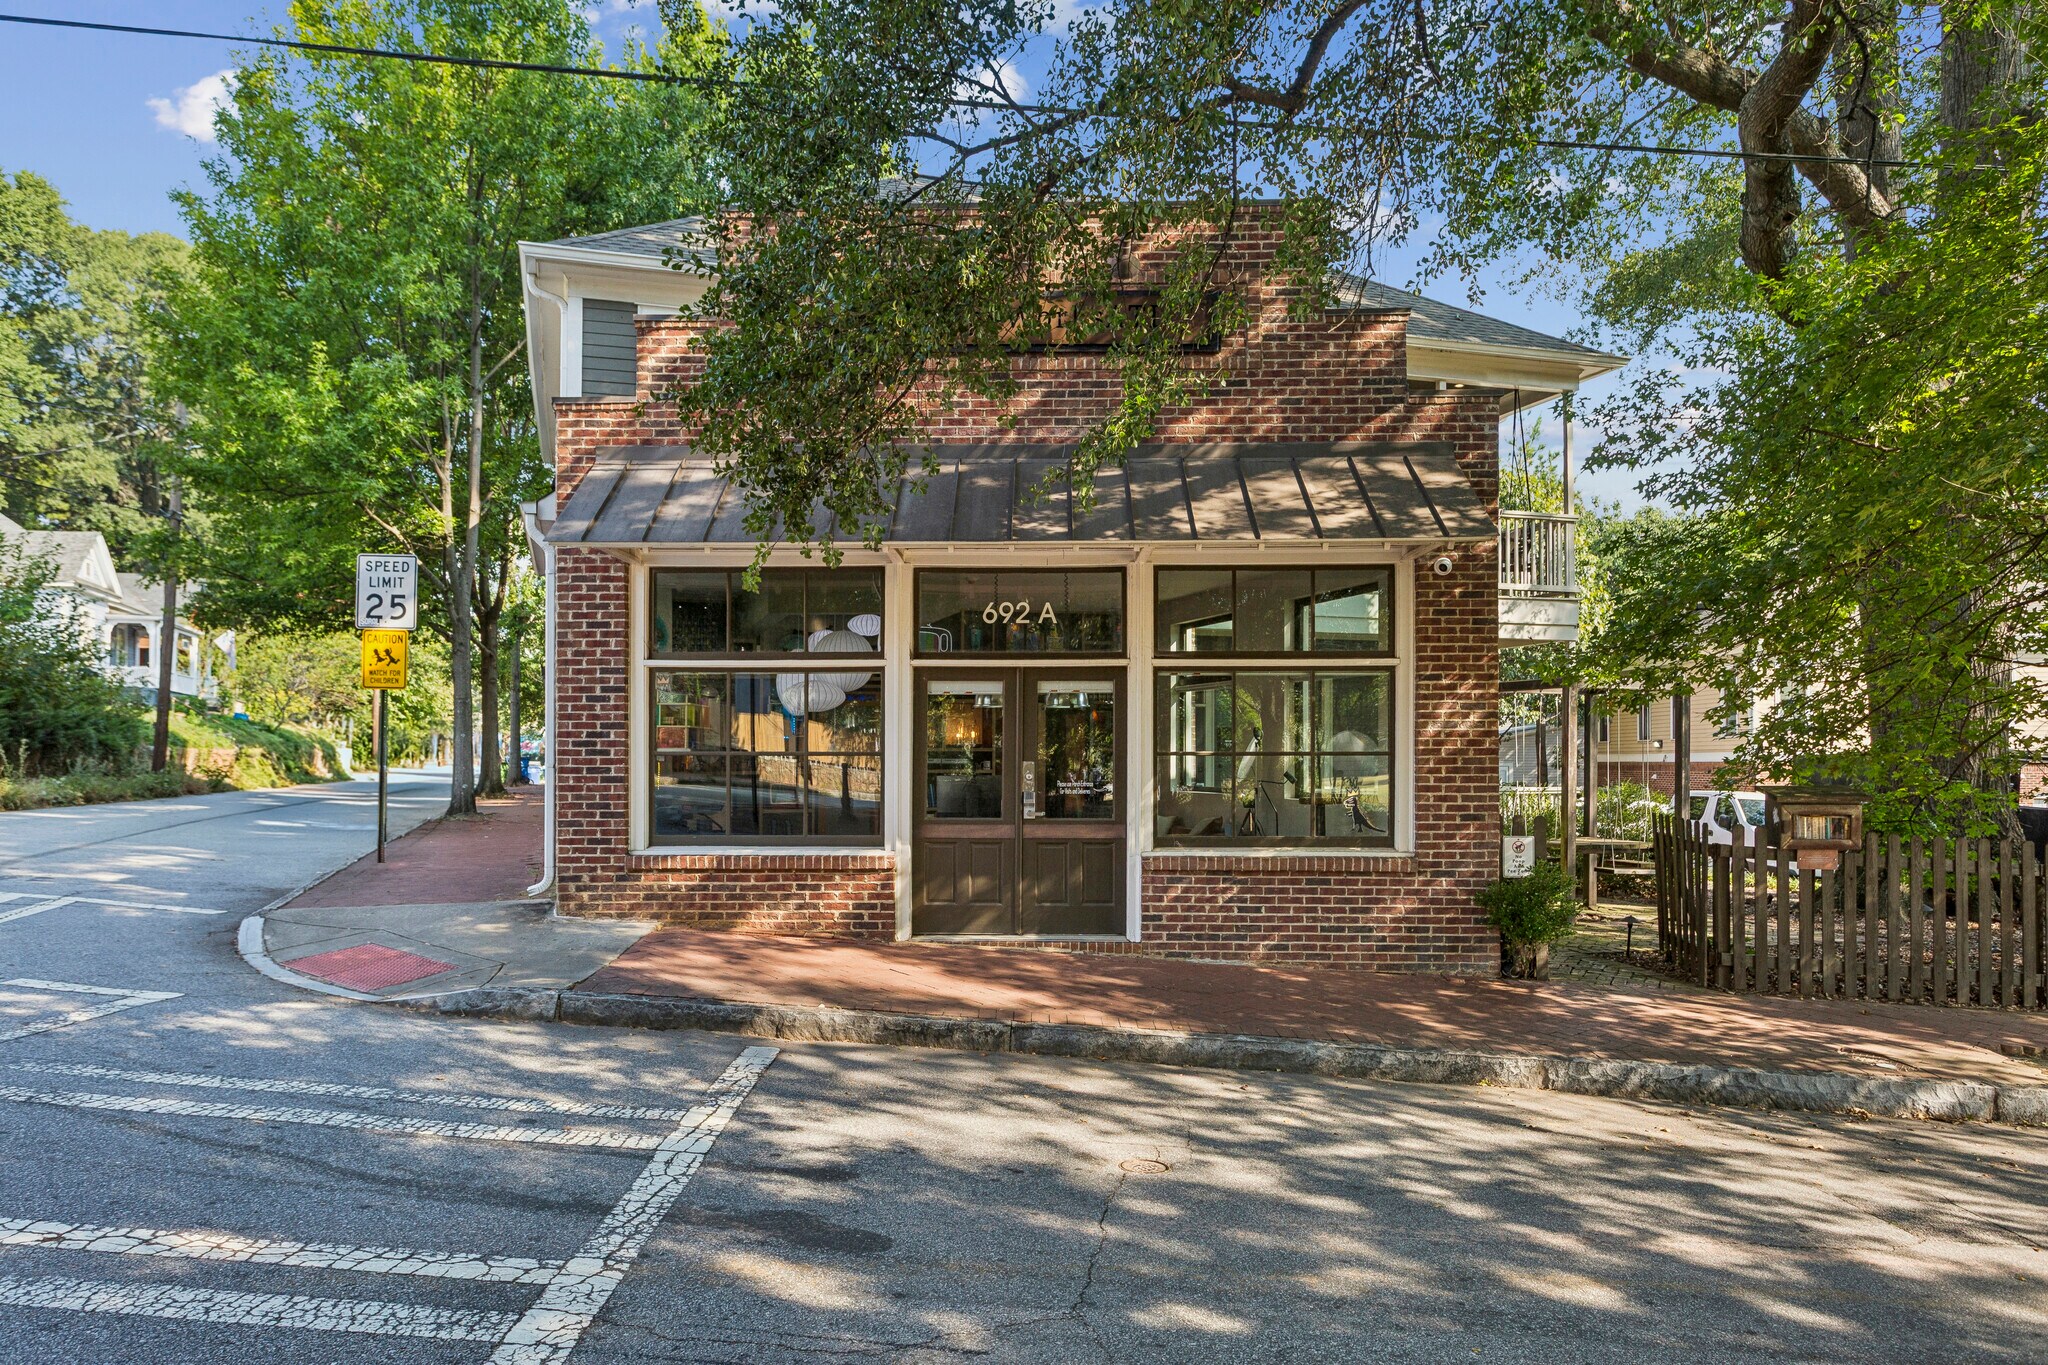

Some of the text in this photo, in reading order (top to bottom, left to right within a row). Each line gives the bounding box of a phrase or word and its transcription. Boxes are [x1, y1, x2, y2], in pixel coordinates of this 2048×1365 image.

[365, 561, 410, 573] SPEED
[369, 577, 404, 588] LIMIT
[365, 593, 407, 620] 25
[982, 601, 1058, 624] 692 A
[367, 634, 403, 644] CAUTION
